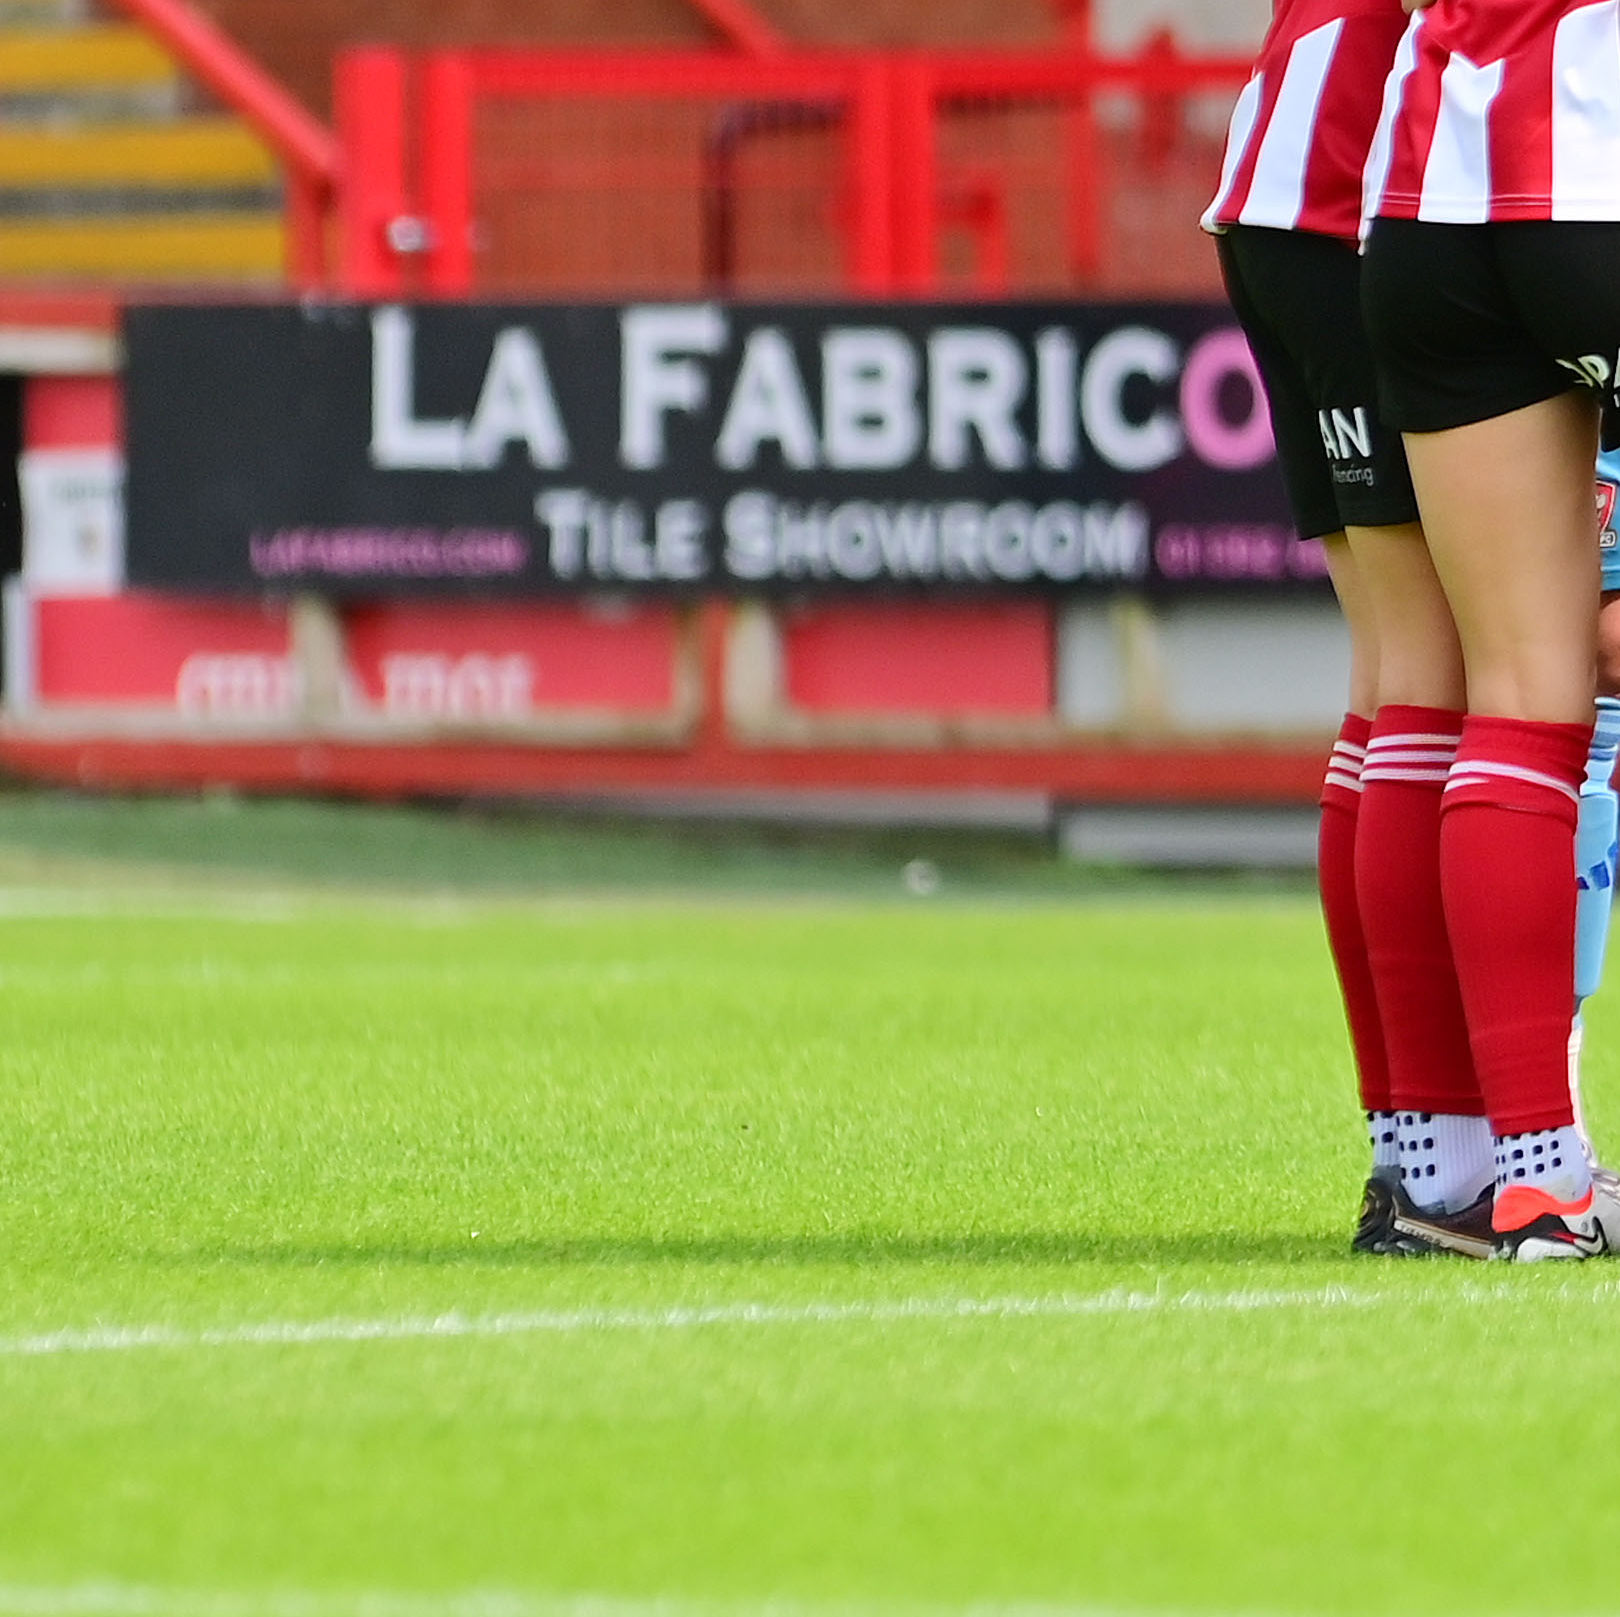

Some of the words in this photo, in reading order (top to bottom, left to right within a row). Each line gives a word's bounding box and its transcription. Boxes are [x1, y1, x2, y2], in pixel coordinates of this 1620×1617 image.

[369, 304, 570, 472] LA
[618, 304, 1278, 471] FABRICO
[534, 489, 706, 580] TILE
[724, 489, 1151, 582] SHOWROOM
